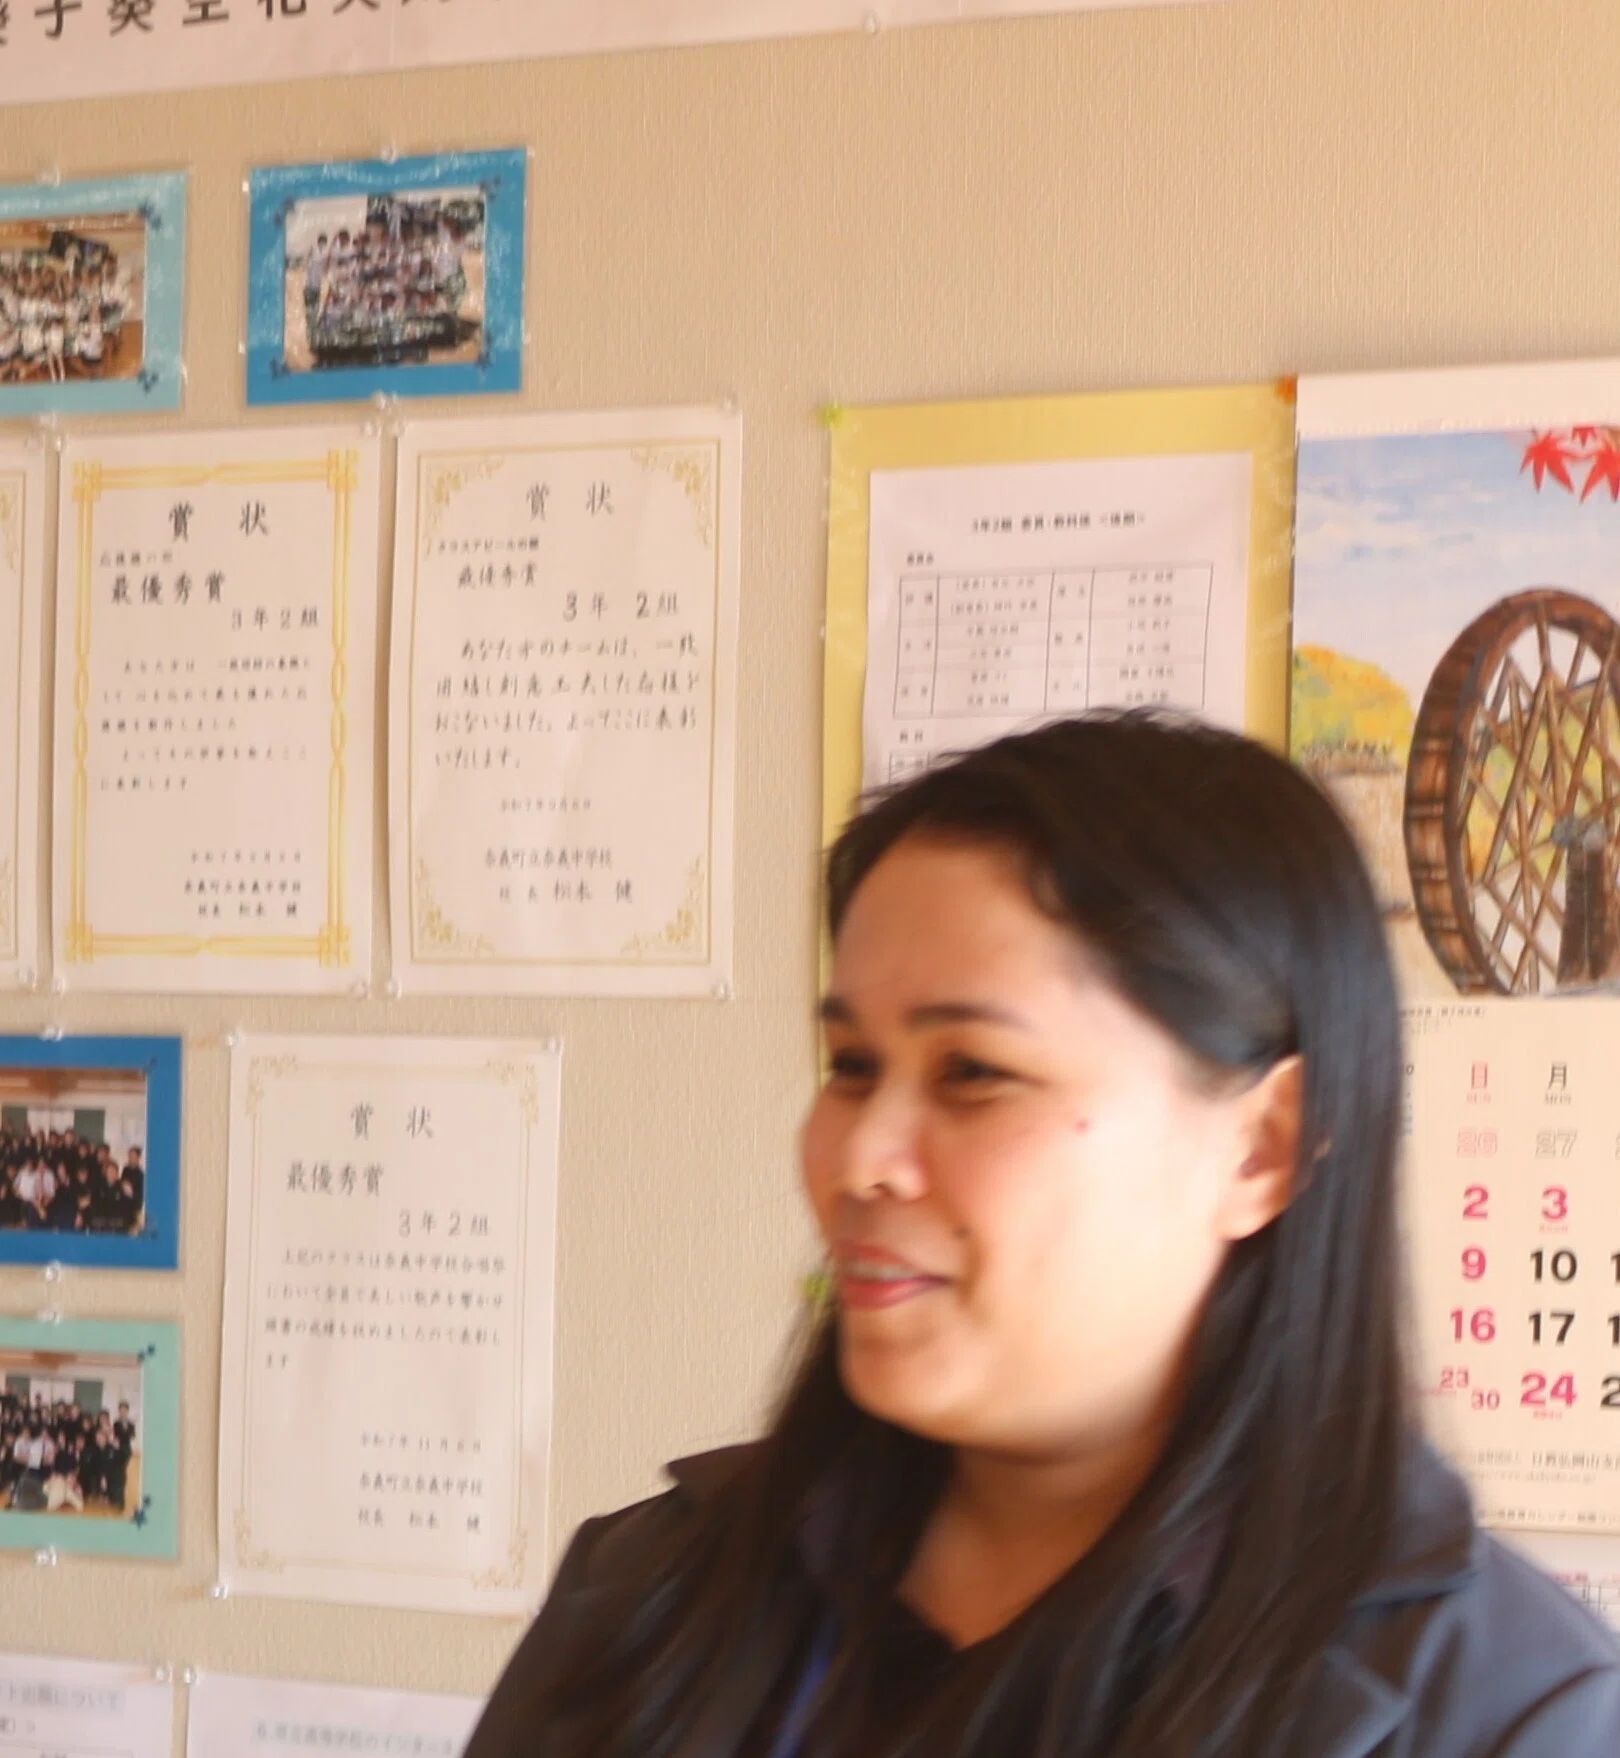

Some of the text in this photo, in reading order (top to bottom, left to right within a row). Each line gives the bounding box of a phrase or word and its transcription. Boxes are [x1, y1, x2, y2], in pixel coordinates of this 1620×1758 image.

[526, 481, 614, 522] 賞状
[169, 500, 269, 543] 賞状
[111, 567, 225, 606] 最優秀賞
[1472, 1062, 1568, 1091] 日 月
[350, 1102, 434, 1141] 賞状
[1457, 1128, 1578, 1158] 26 27
[287, 1160, 385, 1197] 最優秀賞
[1463, 1185, 1568, 1219] 2 3
[1461, 1246, 1487, 1281] 9
[1530, 1250, 1578, 1284] 10
[1449, 1309, 1496, 1344] 16
[1528, 1311, 1576, 1345] 17
[1440, 1366, 1469, 1390] 23
[1519, 1370, 1578, 1408] 24
[1471, 1388, 1501, 1411] 30
